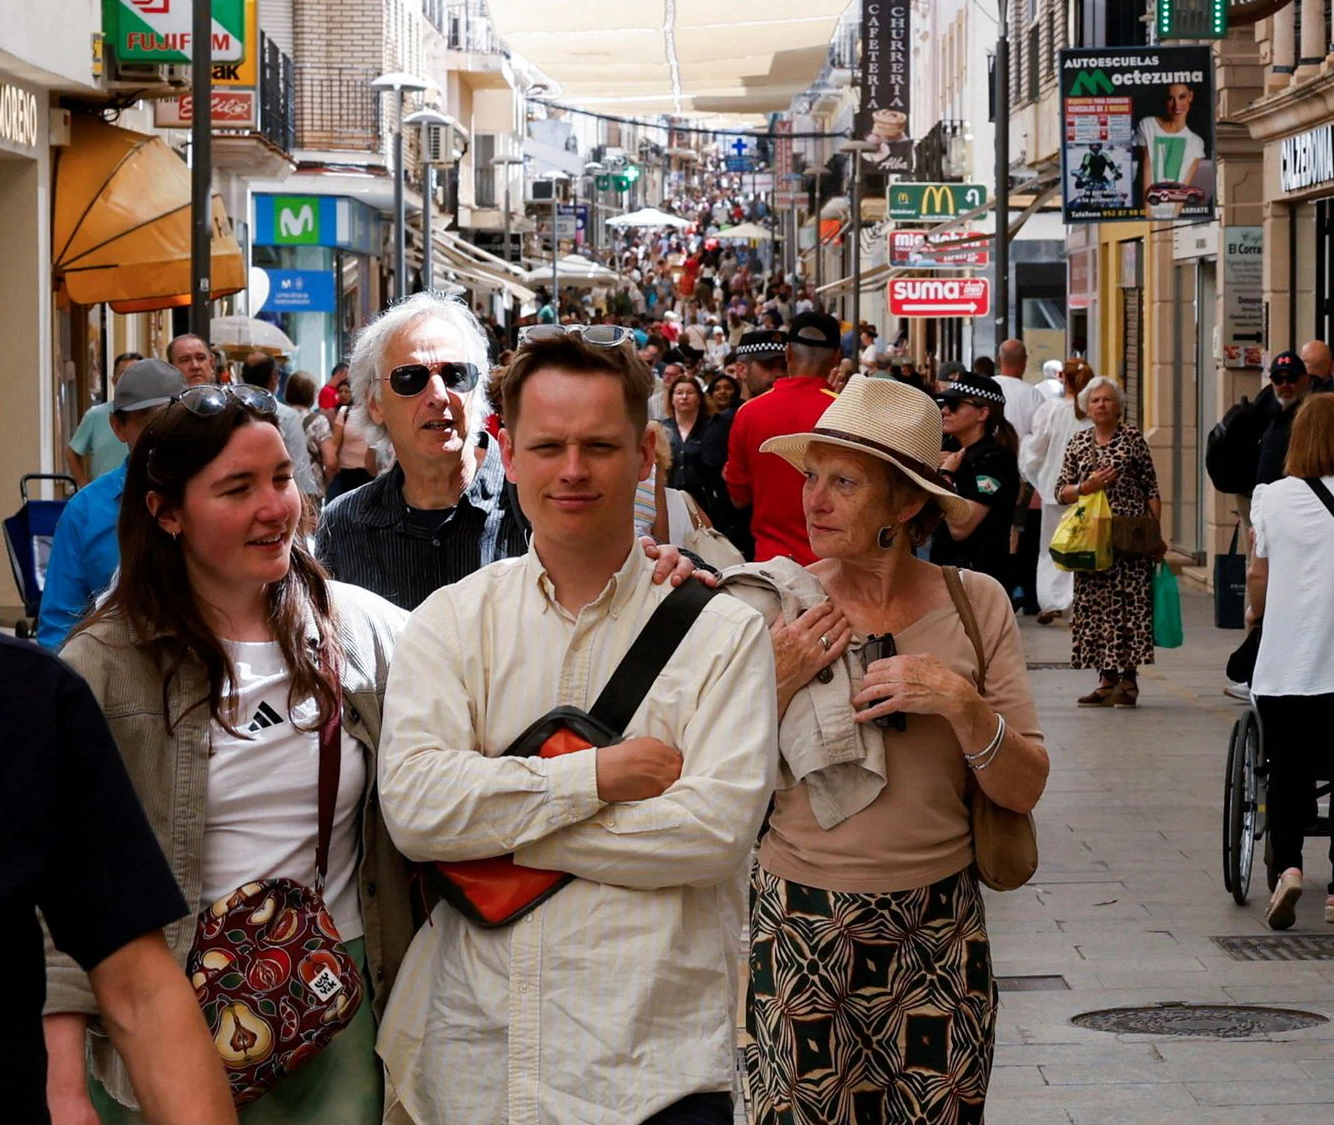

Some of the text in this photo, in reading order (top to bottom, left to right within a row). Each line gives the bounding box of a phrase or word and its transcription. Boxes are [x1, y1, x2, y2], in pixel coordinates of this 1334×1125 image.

[127, 32, 231, 51] FUJIFM
[1064, 55, 1160, 69] AUTOESCUELAS
[1228, 243, 1262, 255] El Corra
[894, 281, 960, 300] suma
